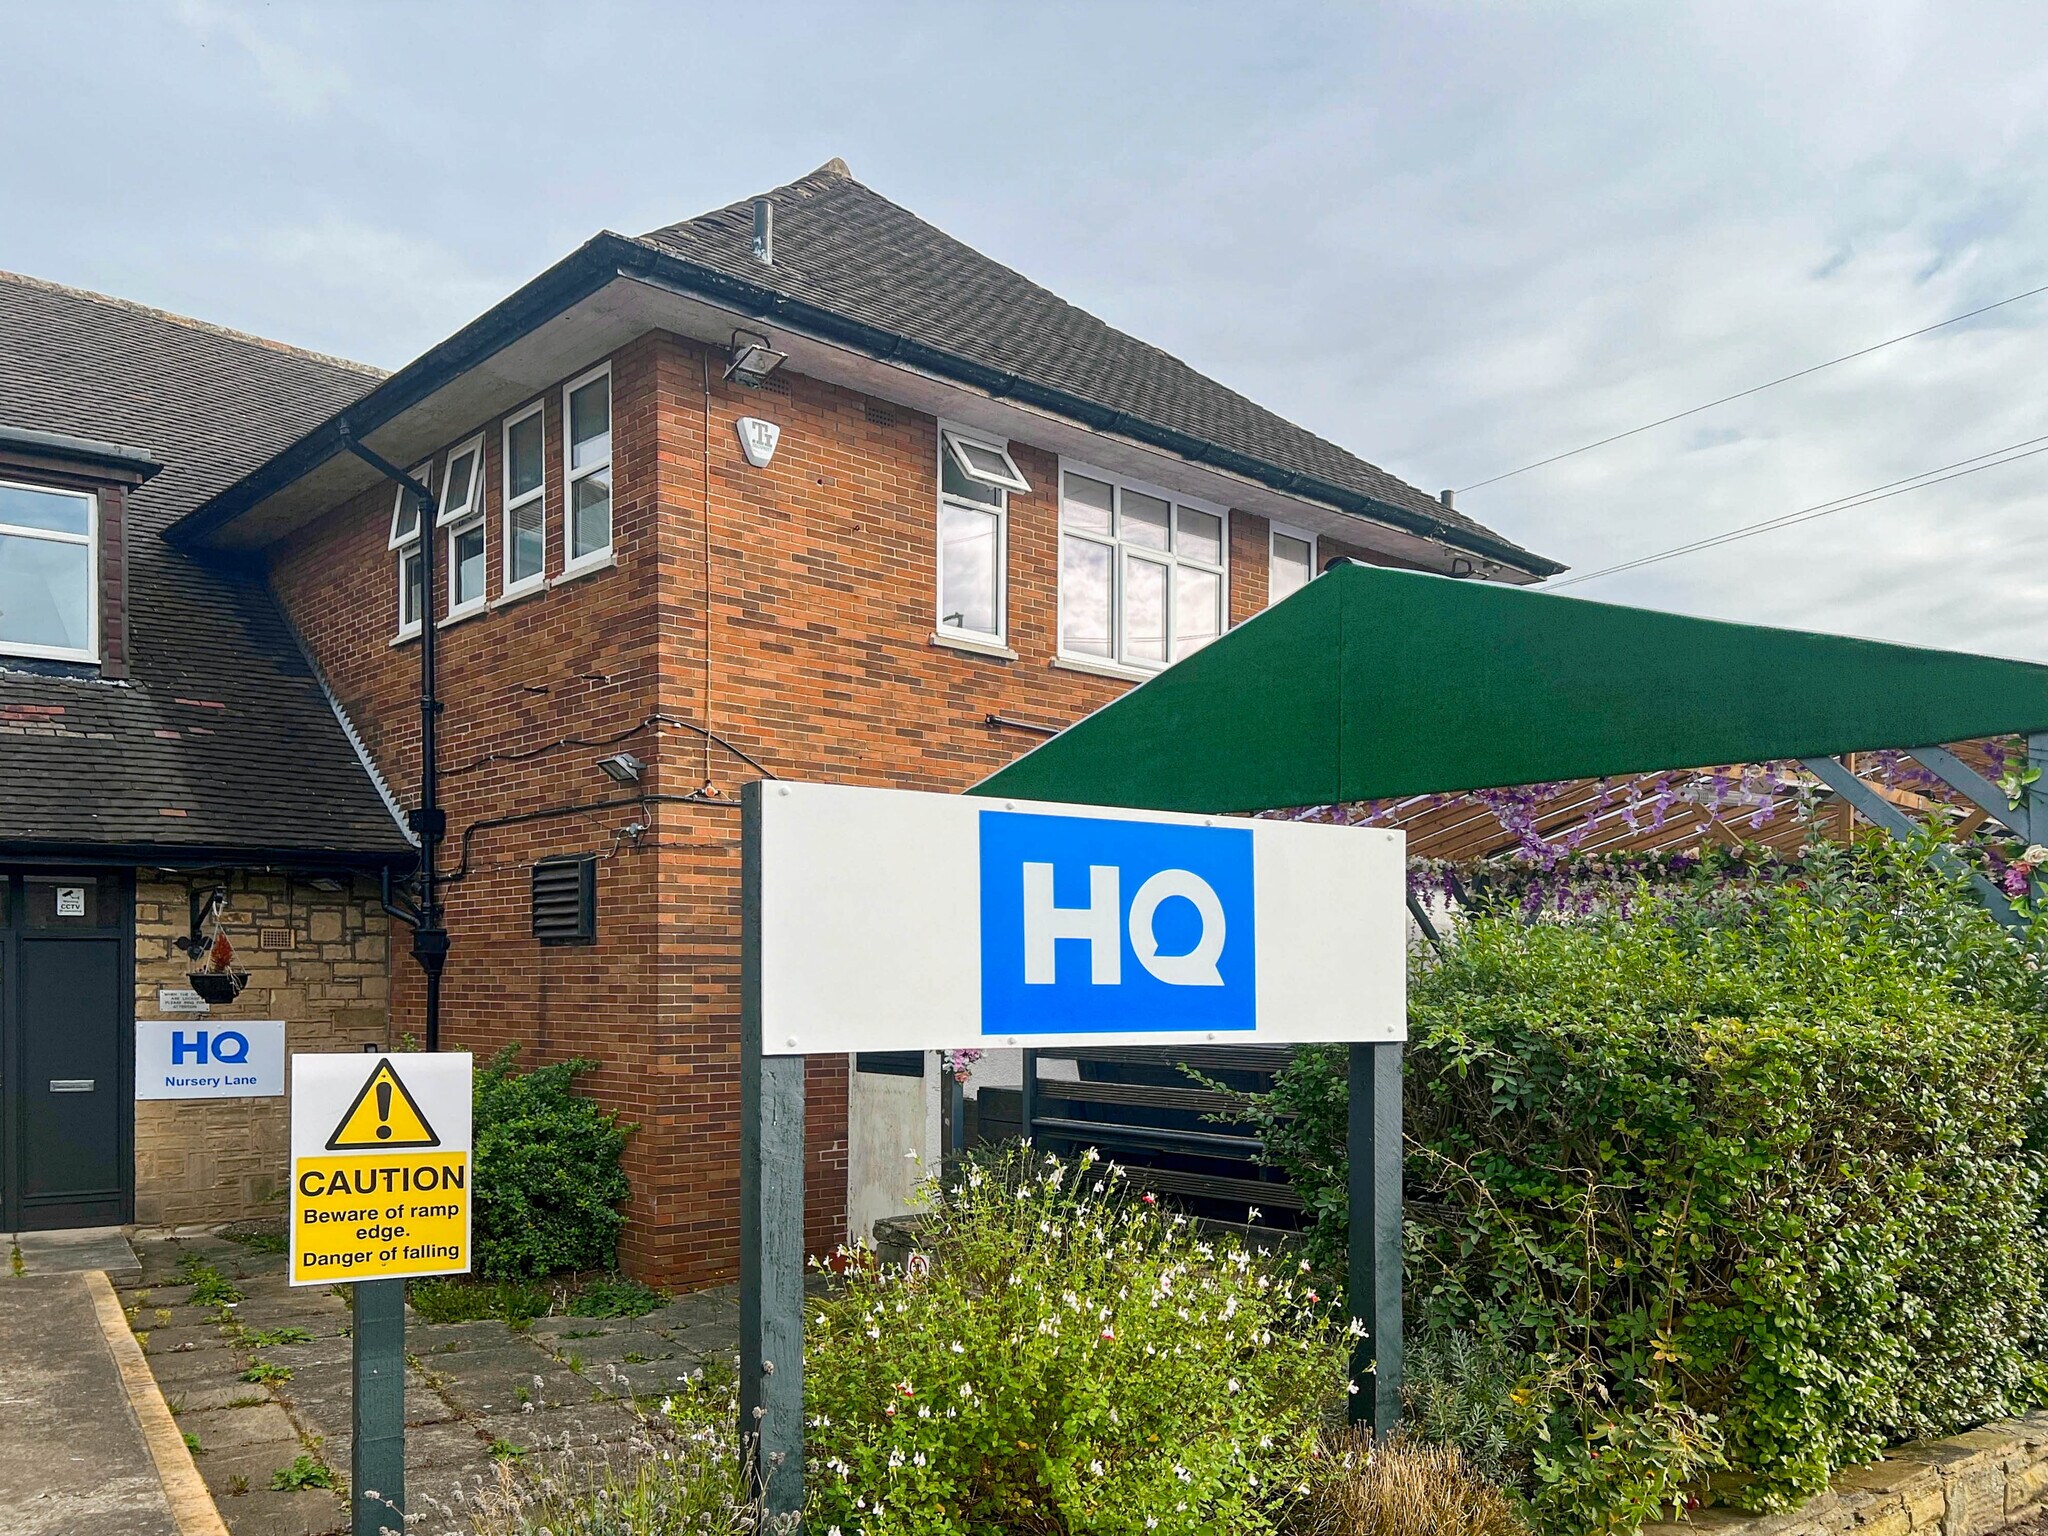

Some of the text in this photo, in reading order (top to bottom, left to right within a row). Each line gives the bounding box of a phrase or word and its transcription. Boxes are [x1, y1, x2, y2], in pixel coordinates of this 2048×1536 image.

[1023, 862, 1226, 986] HQ
[172, 1031, 249, 1065] HQ
[165, 1075, 257, 1088] Nursery Lane
[299, 1165, 465, 1197] CAUTION
[304, 1204, 459, 1224] Beware of ramp
[356, 1225, 410, 1241] edge.
[303, 1245, 459, 1267] Danger of falling
